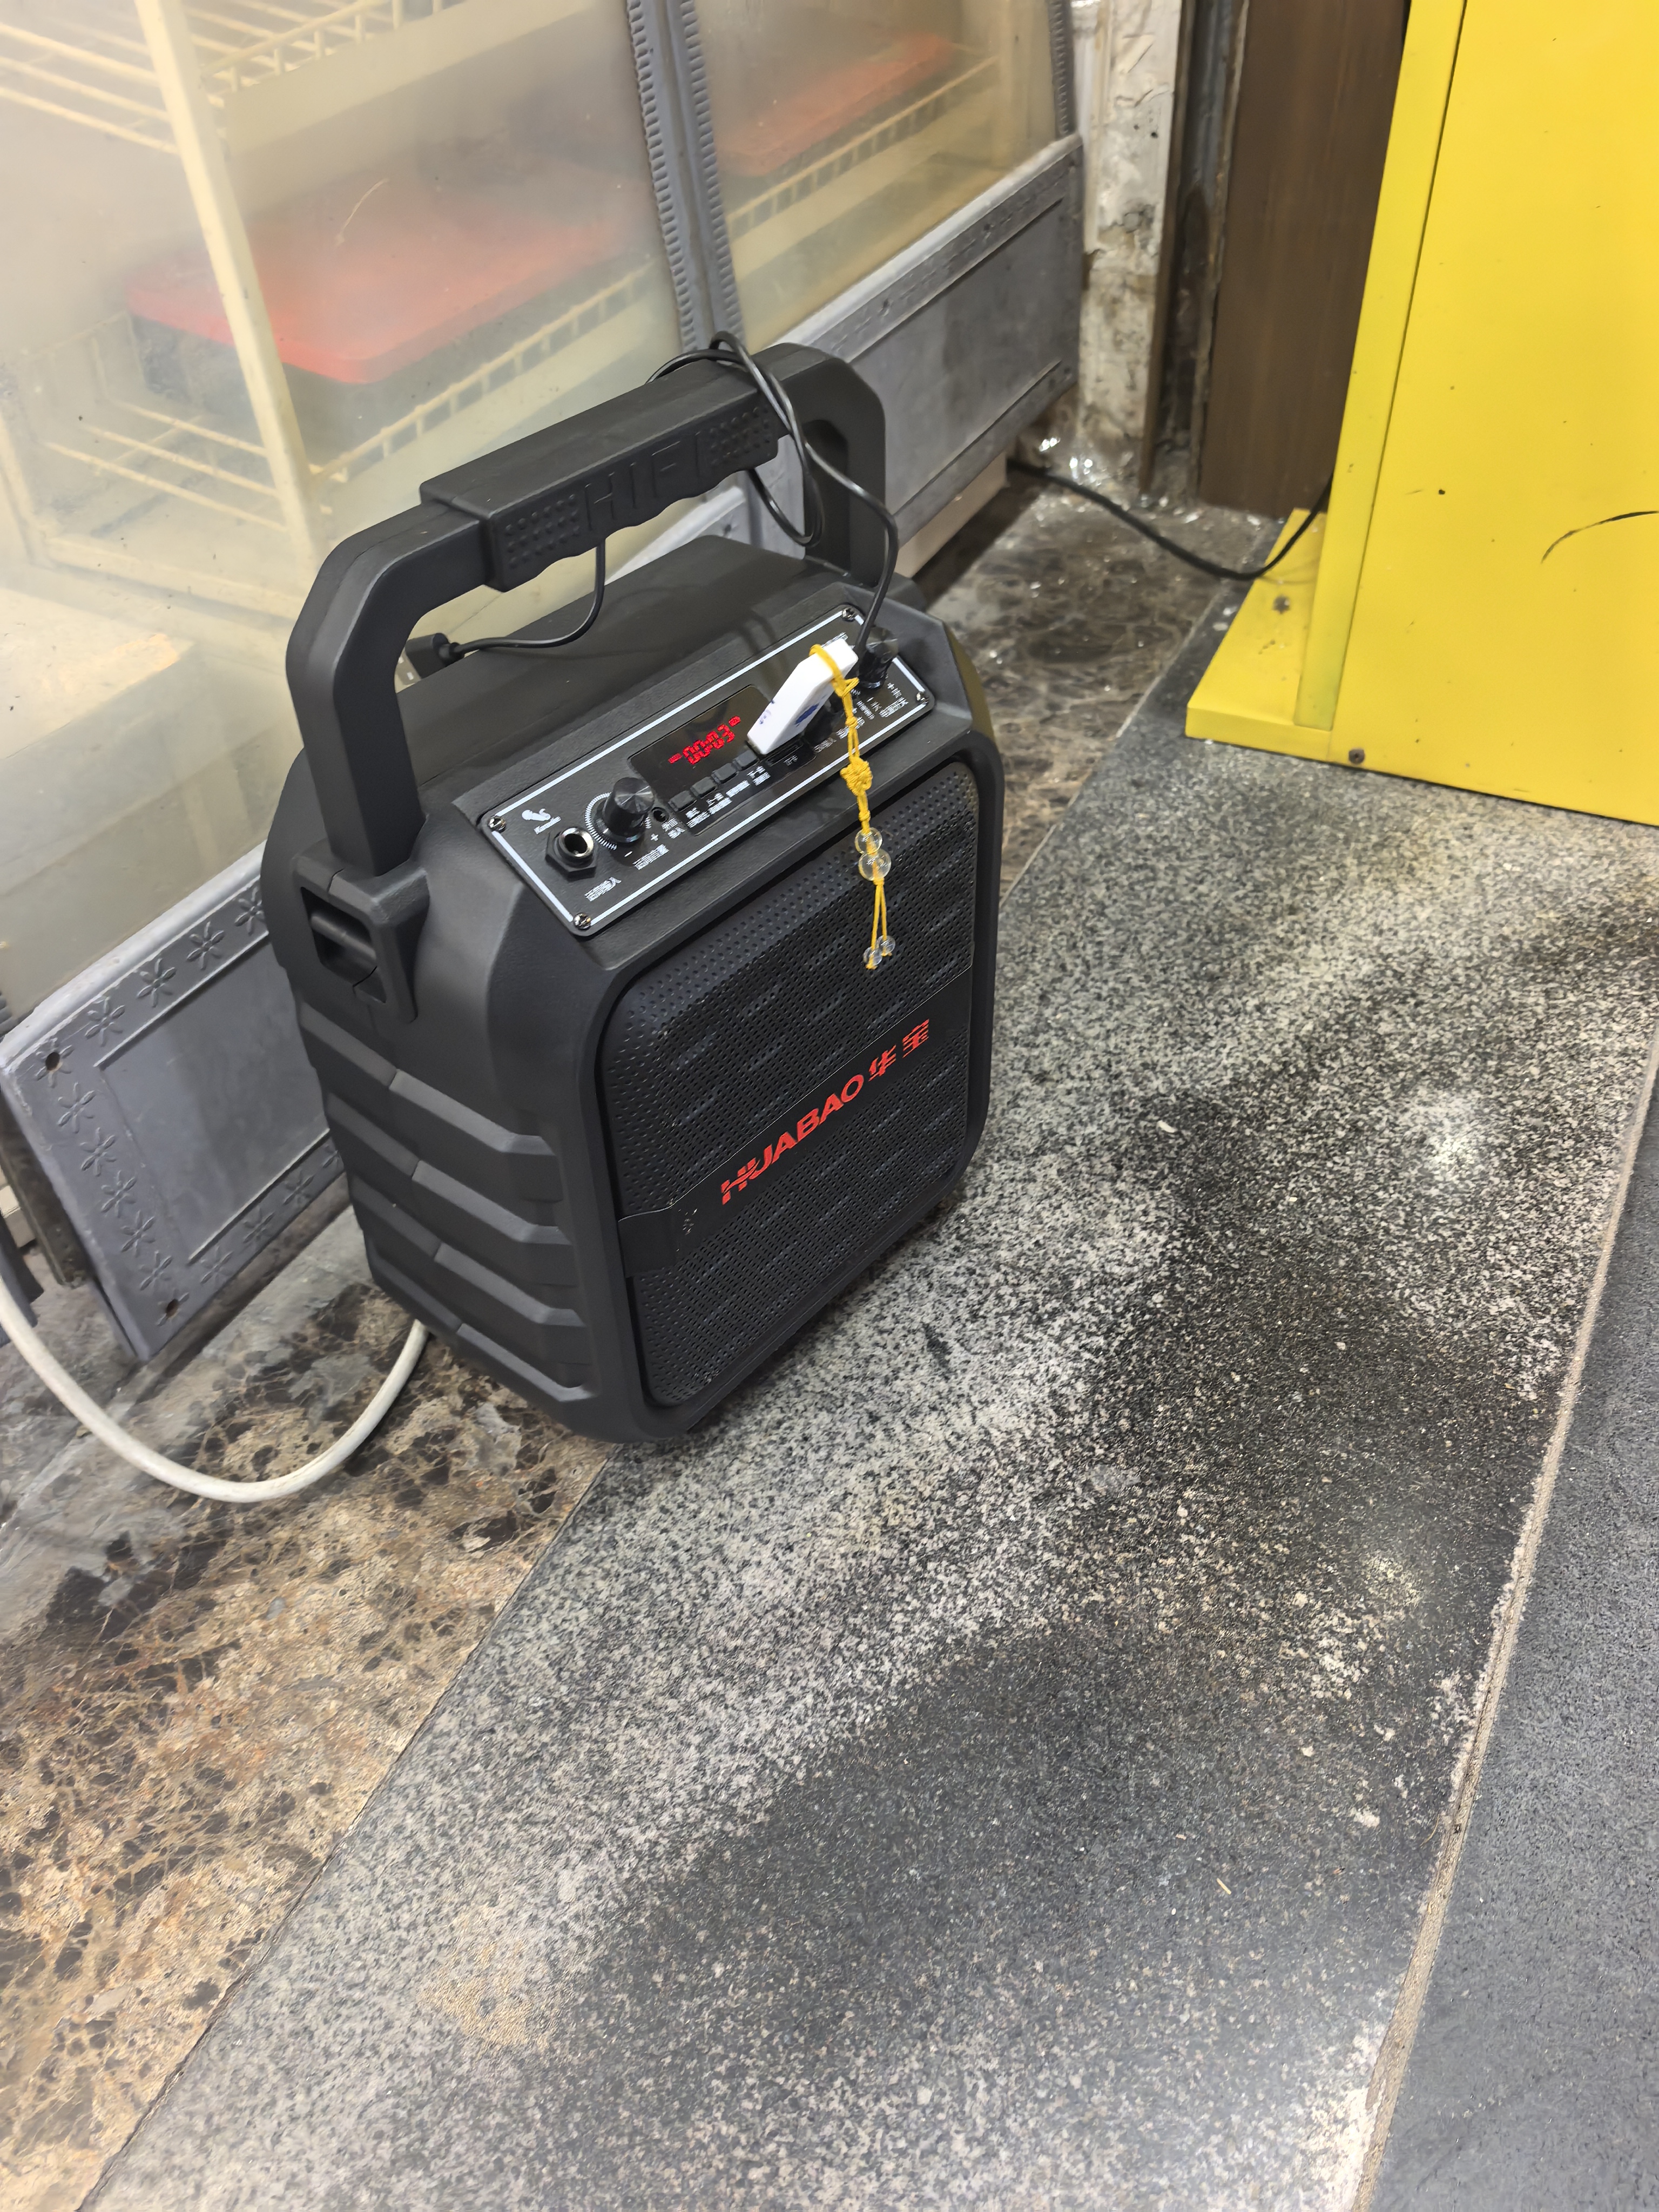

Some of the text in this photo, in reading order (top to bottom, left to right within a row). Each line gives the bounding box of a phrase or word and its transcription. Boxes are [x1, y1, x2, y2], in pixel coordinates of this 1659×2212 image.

[583, 431, 702, 532] HIFI
[720, 1019, 930, 1205] HUABAO 华宝
